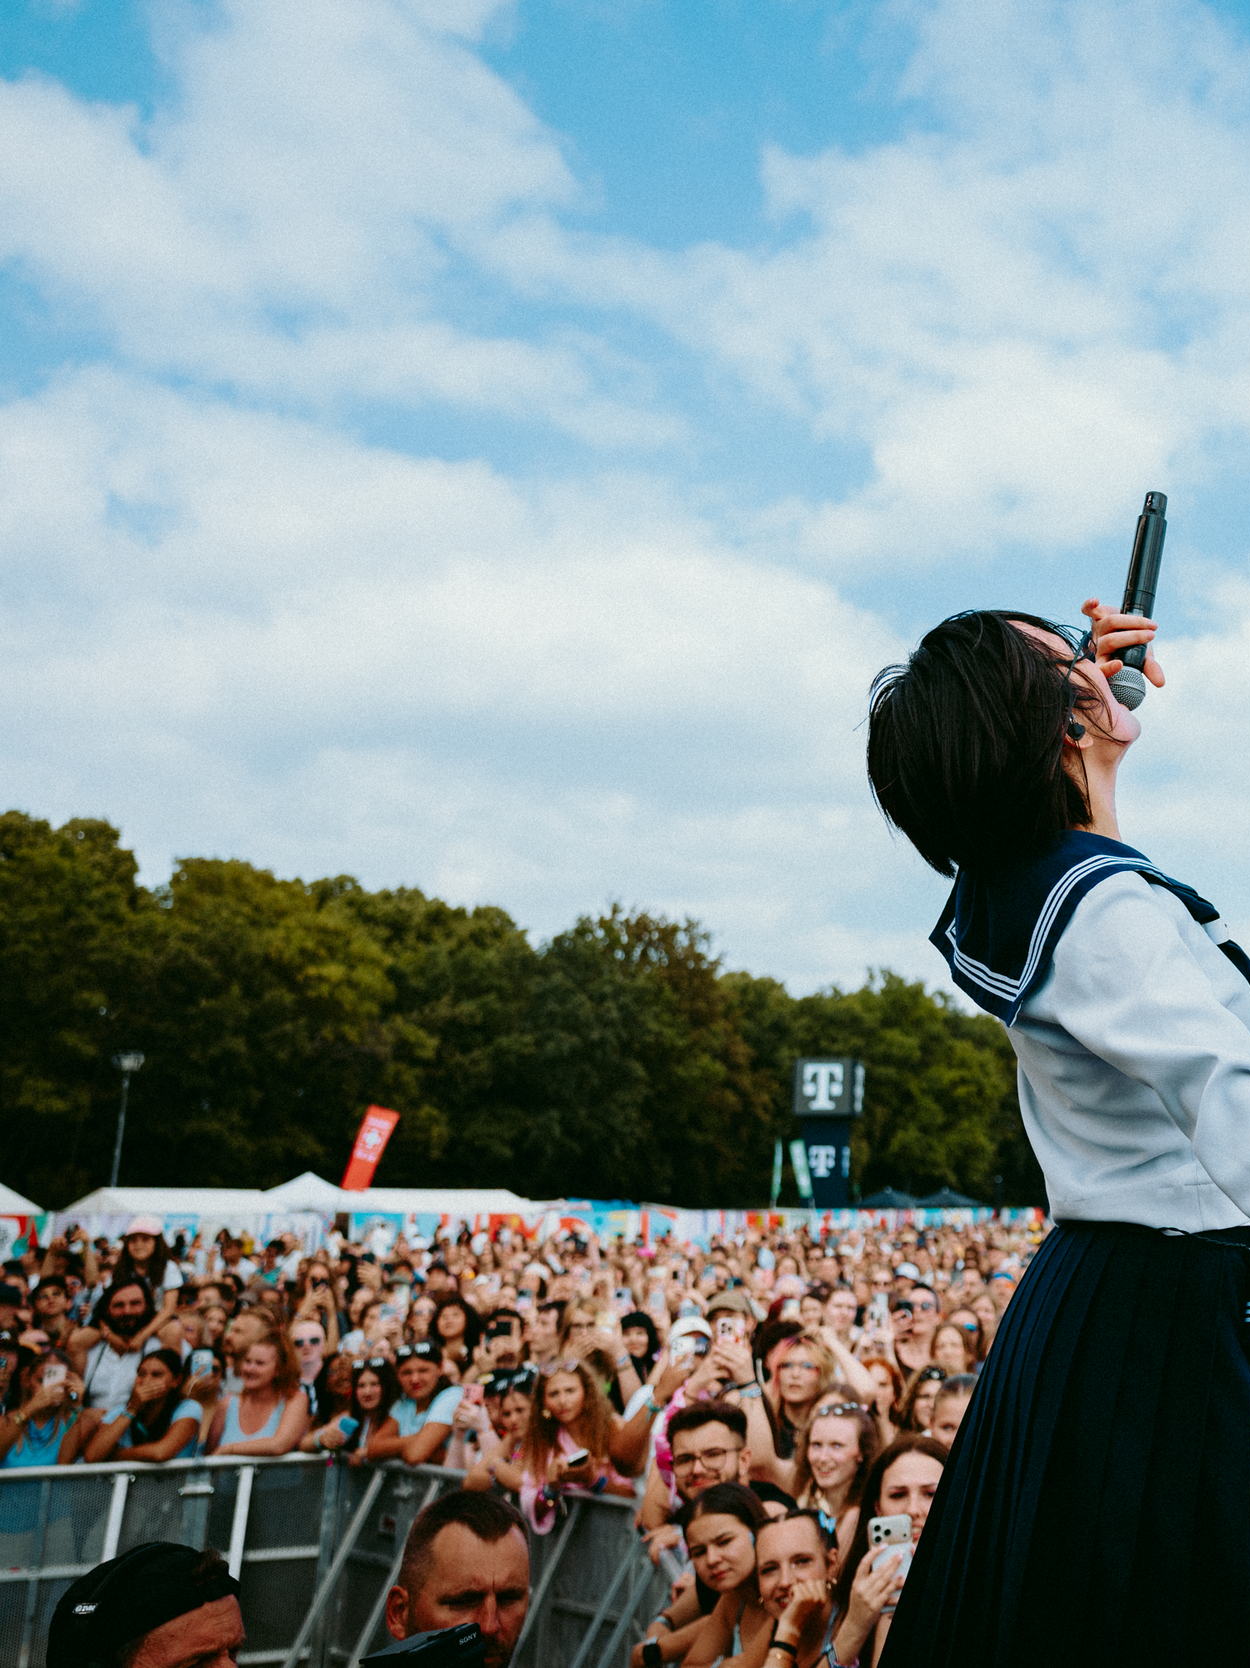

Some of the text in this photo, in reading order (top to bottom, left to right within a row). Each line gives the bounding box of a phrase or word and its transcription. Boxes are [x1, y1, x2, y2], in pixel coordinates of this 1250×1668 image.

[803, 1063, 843, 1110] T
[809, 1145, 836, 1177] T
[459, 1632, 477, 1645] SONY
